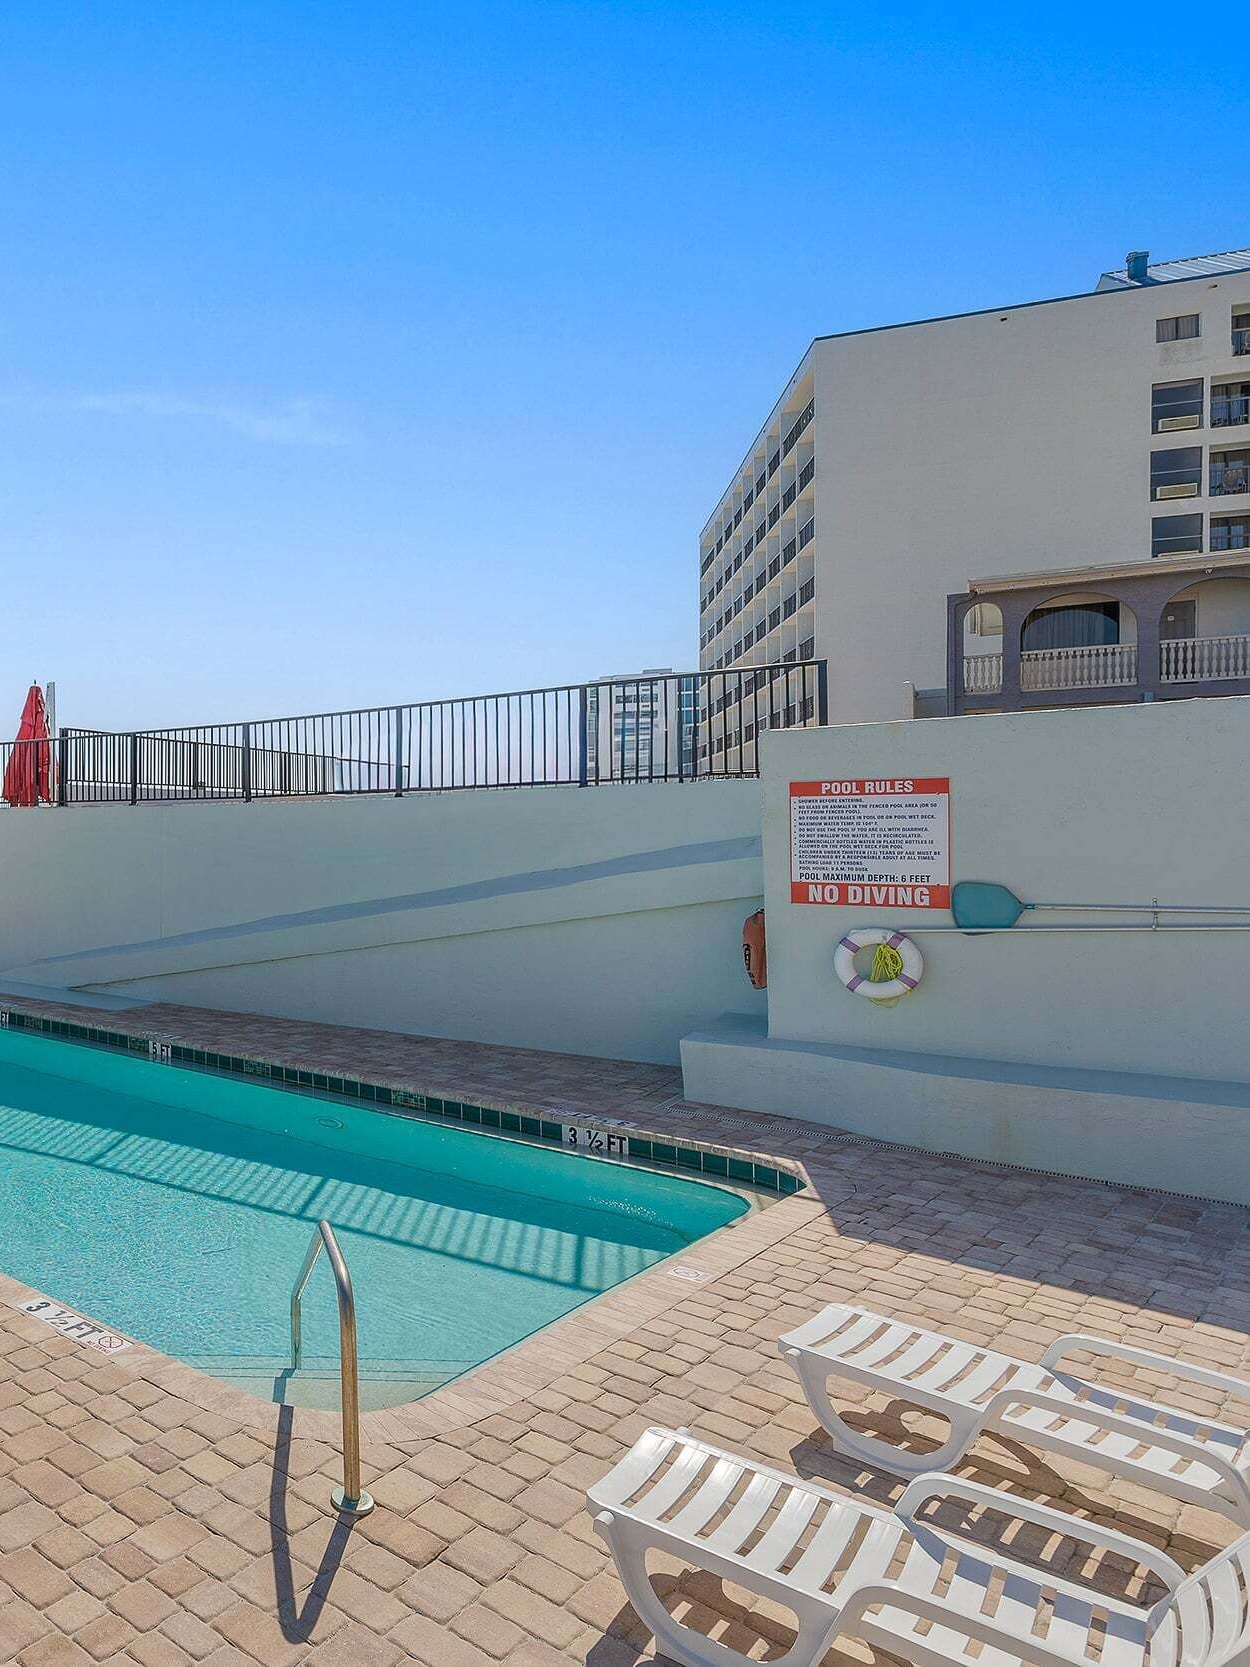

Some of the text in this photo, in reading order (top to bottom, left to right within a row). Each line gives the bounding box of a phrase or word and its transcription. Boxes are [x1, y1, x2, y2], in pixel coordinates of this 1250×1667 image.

[821, 780, 914, 794] POOL RULES
[808, 885, 930, 905] NO DIVING
[152, 1042, 170, 1056] 5 FT
[568, 1127, 578, 1144] 3
[607, 1134, 626, 1153] FT
[26, 1302, 51, 1312] 3
[63, 1321, 104, 1338] FT
